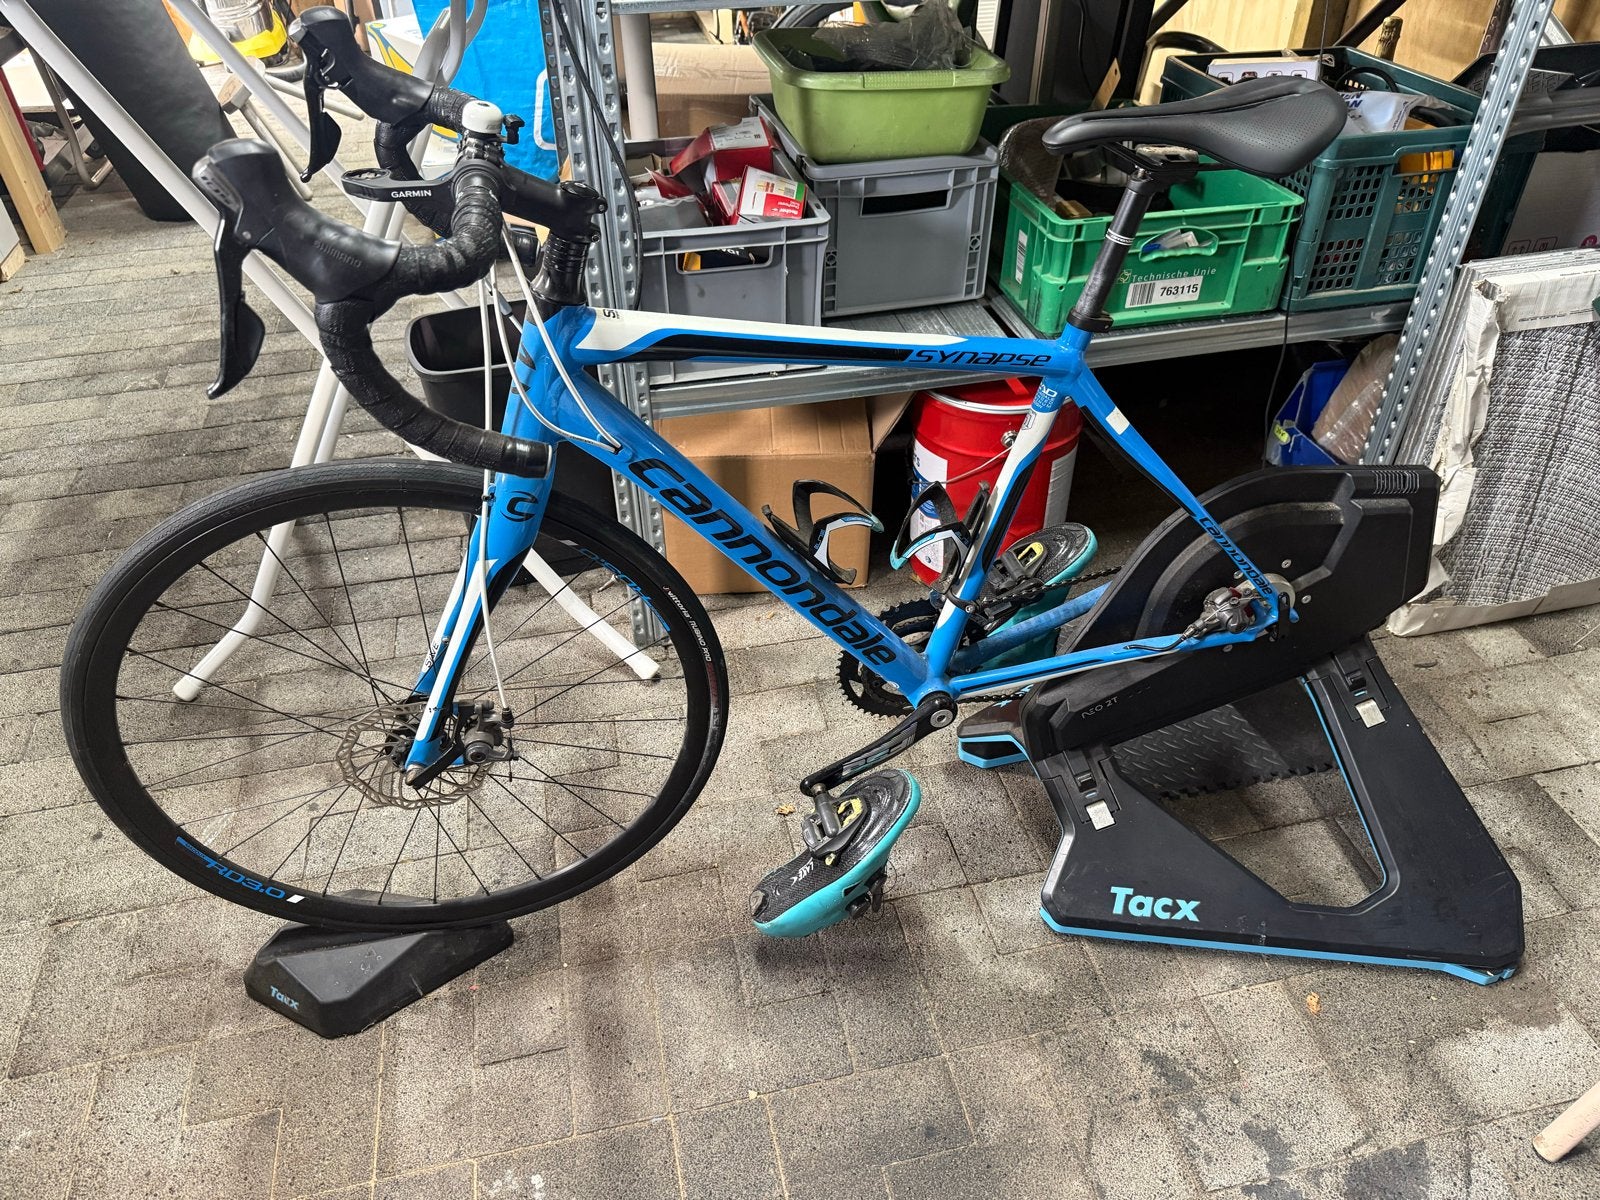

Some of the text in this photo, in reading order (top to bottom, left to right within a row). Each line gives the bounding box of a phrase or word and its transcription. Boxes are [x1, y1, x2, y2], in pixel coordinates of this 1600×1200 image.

[391, 190, 432, 198] GARMIN
[1132, 266, 1217, 283] Technische Unie
[1160, 283, 1199, 297] 763115
[667, 591, 712, 662] vittoria RUBINO PRO
[1081, 696, 1118, 719] NEO 2T
[206, 860, 286, 899] RD3.0
[1110, 886, 1201, 922] Tacx
[270, 985, 299, 1010] Tacx
